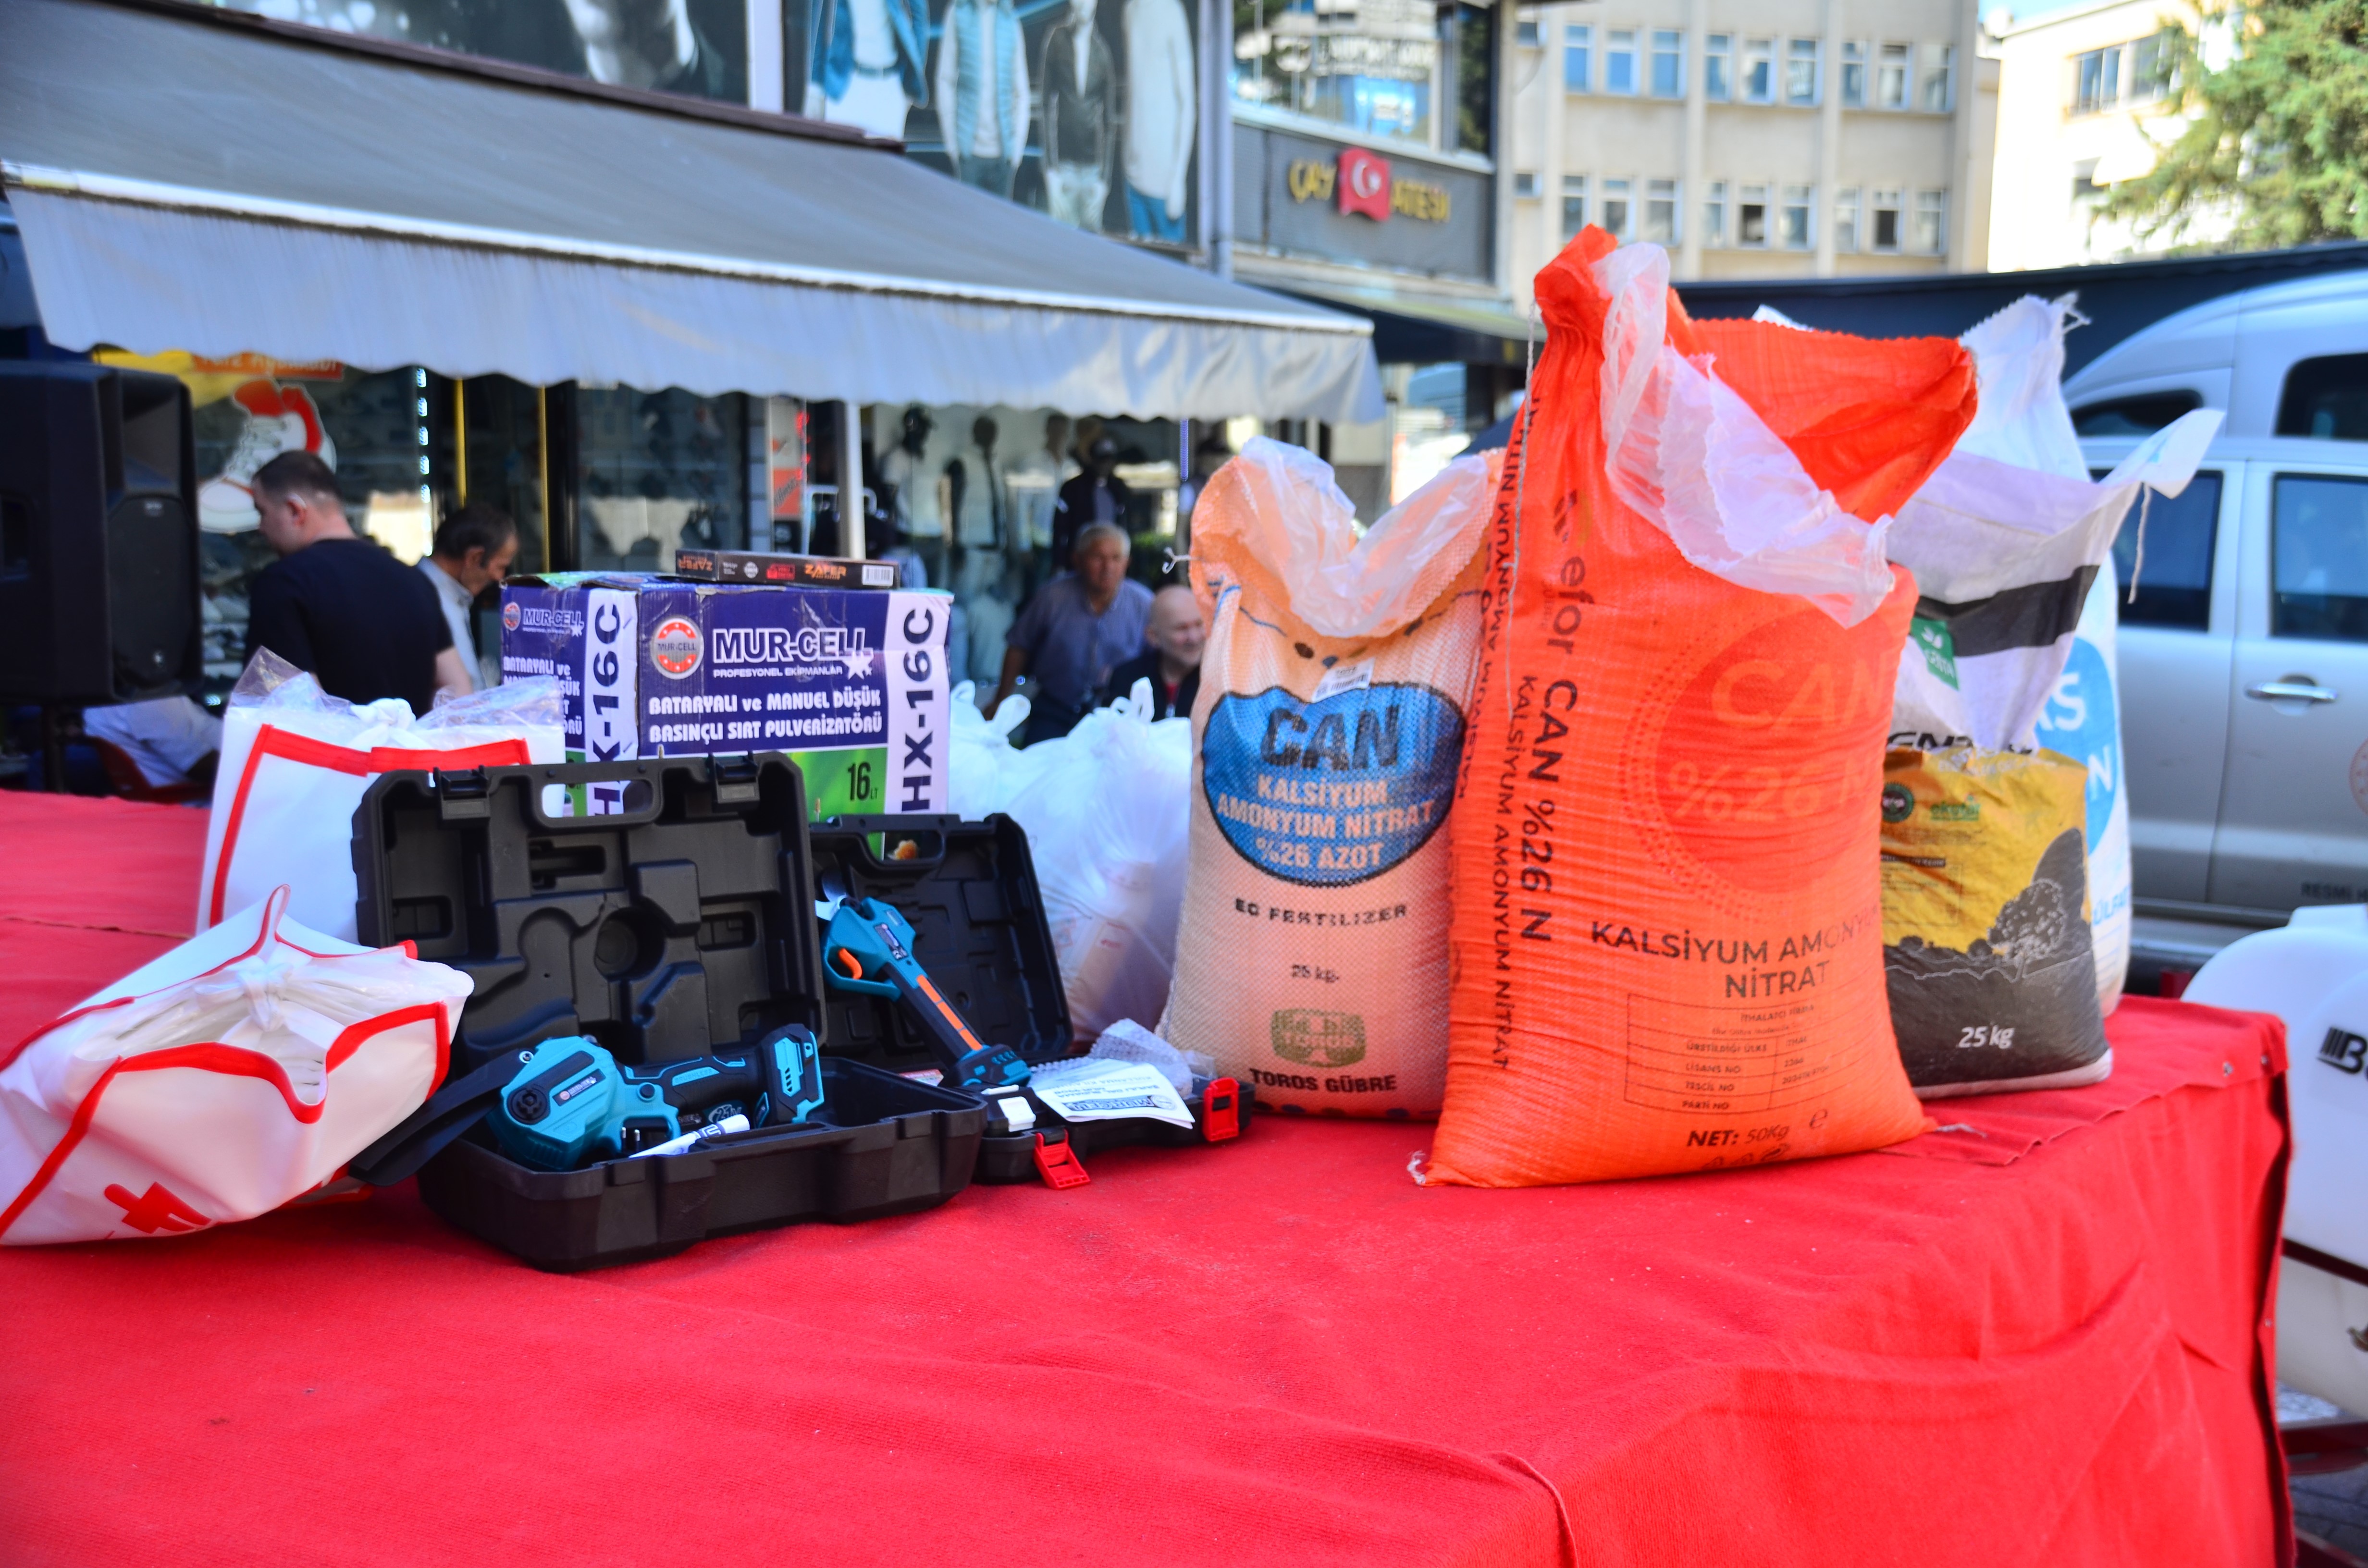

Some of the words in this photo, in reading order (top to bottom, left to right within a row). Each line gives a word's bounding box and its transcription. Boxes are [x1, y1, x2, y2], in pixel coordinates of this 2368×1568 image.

[804, 563, 847, 577] ZAFER
[1547, 556, 1595, 654] efor
[713, 628, 873, 663] MUR-CELL
[504, 656, 554, 675] BATARYALI
[557, 664, 571, 676] ve
[714, 667, 783, 678] PROFESYONEL
[785, 665, 842, 676] EKİPMANLAR
[649, 695, 738, 715] BATARYALI
[742, 698, 762, 711] ve
[767, 690, 830, 711] MANUEL
[833, 686, 881, 711] DÜŞÜK
[901, 607, 934, 812] HX-16C
[649, 723, 723, 745] BASINÇLI
[728, 721, 761, 739] SIRT
[765, 711, 882, 738] PULVERİZATÖRÜ
[1261, 704, 1399, 771] CAN
[1496, 675, 1538, 815] KALSİYUM
[1529, 679, 1579, 783] CAN
[1257, 774, 1389, 808] KALSİYUM
[1217, 792, 1336, 838] AMONYUM
[1345, 799, 1435, 837] NİTRAT
[1256, 838, 1310, 868] %26
[1317, 842, 1384, 870] AZOT
[1521, 798, 1555, 893] %26
[1492, 824, 1511, 971] AMONYUM
[1520, 908, 1552, 942] N
[1591, 920, 1768, 964] KALSİYUM
[1725, 961, 1830, 998] NİTRAT
[1493, 980, 1515, 1069] NİTRAT
[1958, 1026, 1987, 1048] 25
[1989, 1023, 2016, 1049] kg
[1249, 1067, 1317, 1091] TOROS
[1325, 1074, 1397, 1092] GÜBRE
[1687, 1129, 1739, 1147] NET:
